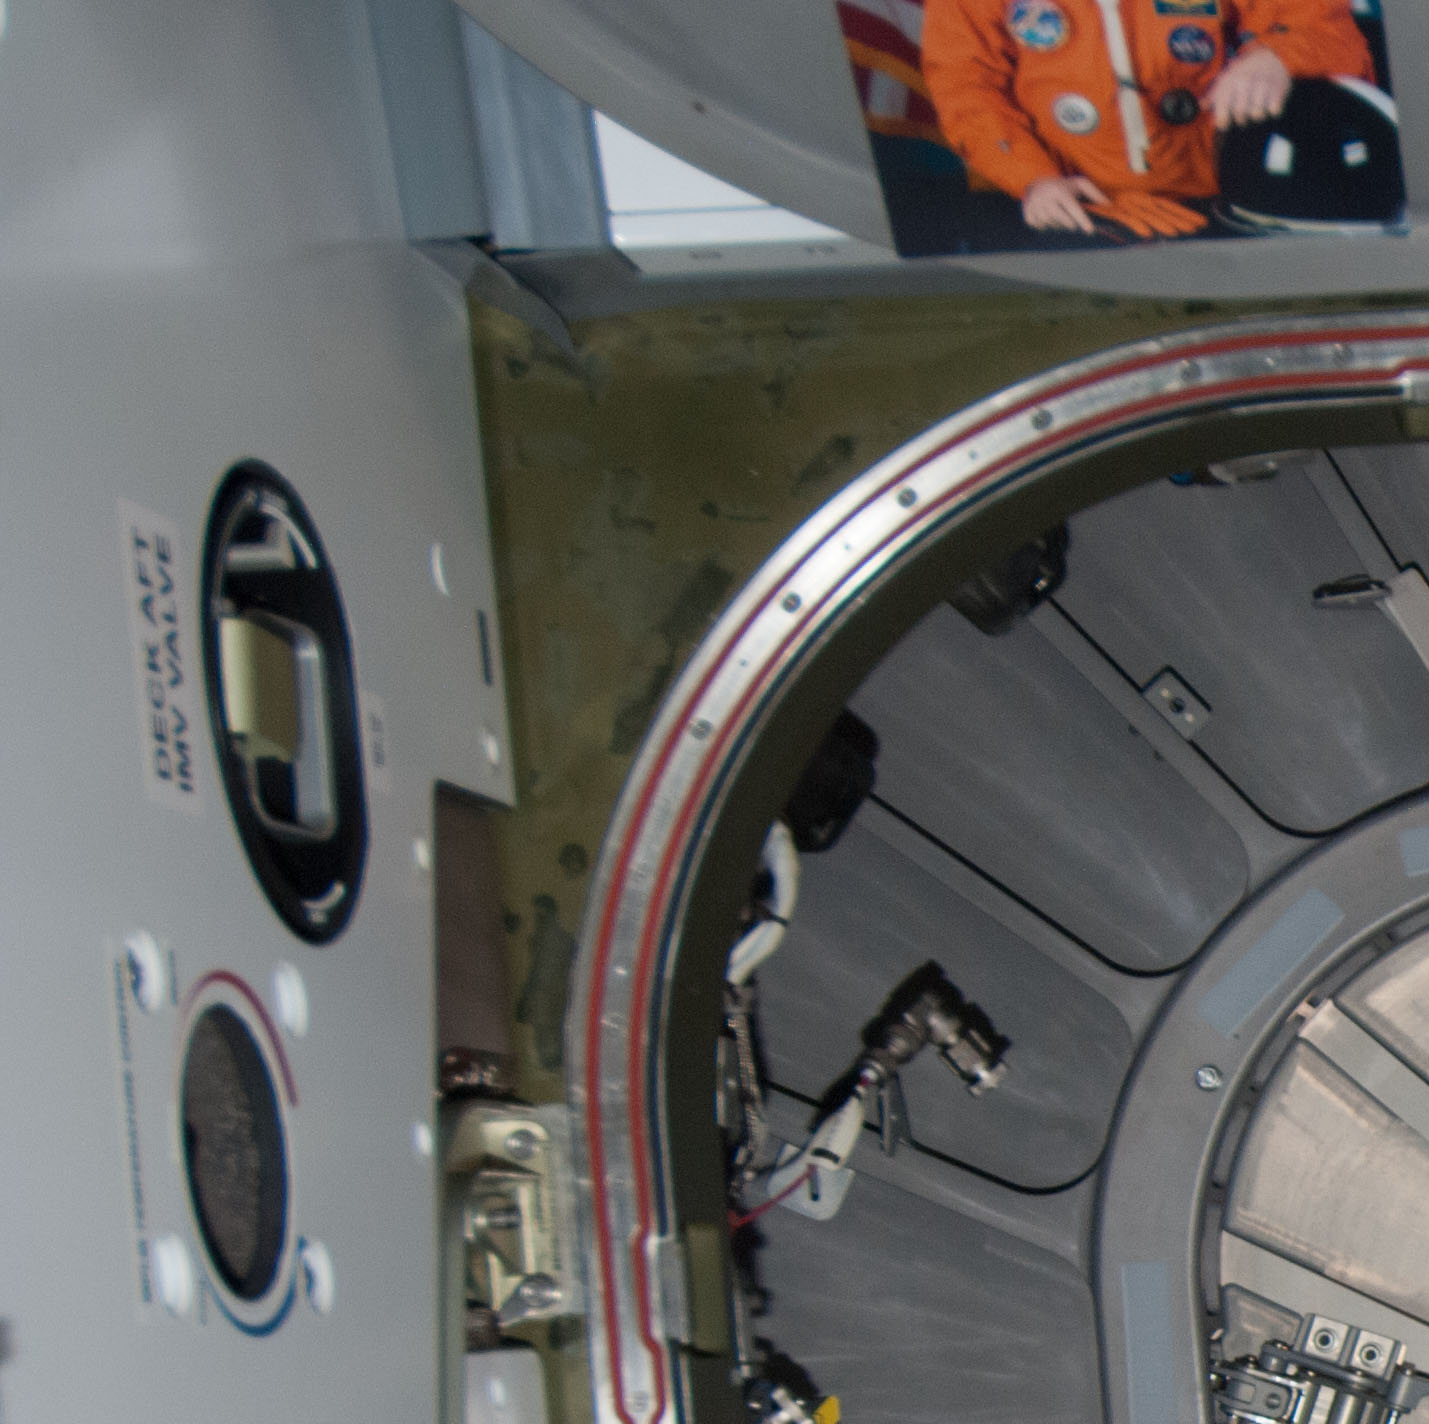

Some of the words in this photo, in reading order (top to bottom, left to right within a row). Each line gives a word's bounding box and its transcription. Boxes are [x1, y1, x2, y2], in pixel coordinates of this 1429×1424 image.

[131, 524, 158, 627] AFT
[155, 534, 185, 689] VALVE
[170, 703, 195, 795] IMV
